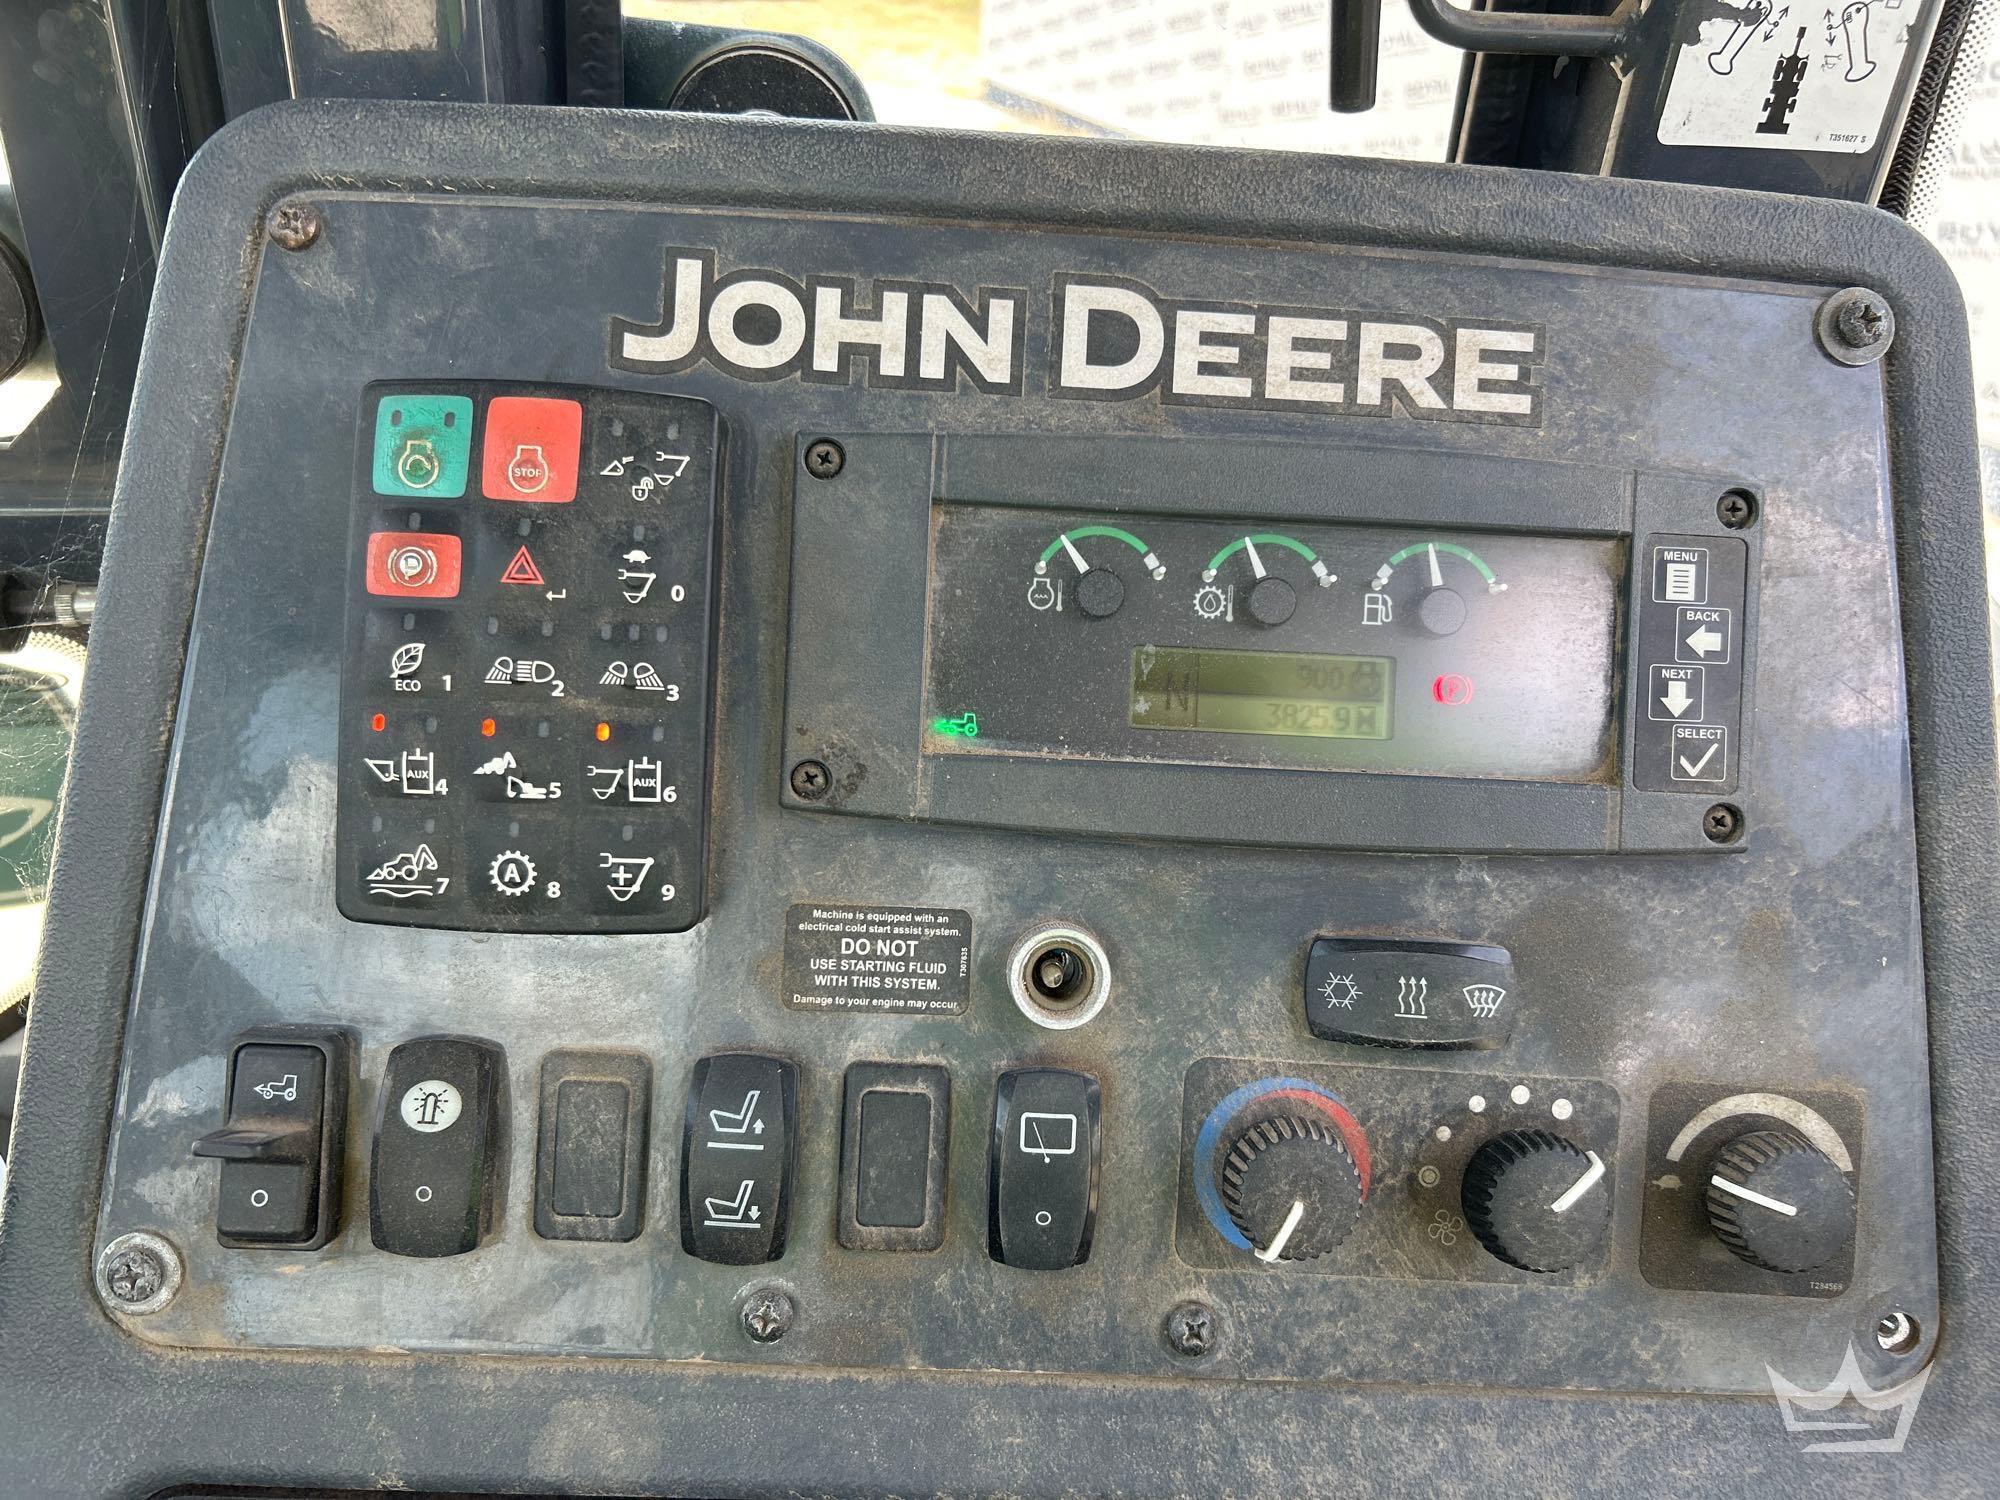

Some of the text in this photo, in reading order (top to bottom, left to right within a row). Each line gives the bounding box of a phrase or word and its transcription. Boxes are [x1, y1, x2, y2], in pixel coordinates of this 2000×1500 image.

[621, 257, 1535, 415] JOHN DEERE
[514, 467, 542, 478] STOP
[1663, 551, 1698, 562] MENU
[670, 585, 685, 602] 0
[1686, 611, 1720, 622] BACK
[1662, 669, 1693, 679] NEXT
[395, 679, 421, 692] ECO
[442, 675, 452, 692] 1
[551, 680, 564, 697] 2
[666, 685, 680, 701] 3
[1677, 728, 1722, 740] SELECT
[407, 770, 429, 780] AUX
[633, 777, 656, 787] AUX
[435, 779, 448, 796] 4
[549, 782, 561, 798] 5
[663, 785, 677, 802] 6
[437, 877, 450, 895] 7
[547, 881, 561, 899] 8
[661, 883, 675, 901] 9
[813, 909, 948, 924] Machine is equipped with an
[799, 923, 962, 937] electrical cold start assist system.
[841, 938, 919, 957] DO NOT
[810, 958, 947, 974] USE STARTING FLUID
[815, 975, 941, 990] WITH THIS SYSTEM.
[793, 994, 833, 1006] Damage
[835, 997, 845, 1005] to
[847, 998, 870, 1007] your
[872, 998, 905, 1008] engine
[907, 1000, 927, 1009] may
